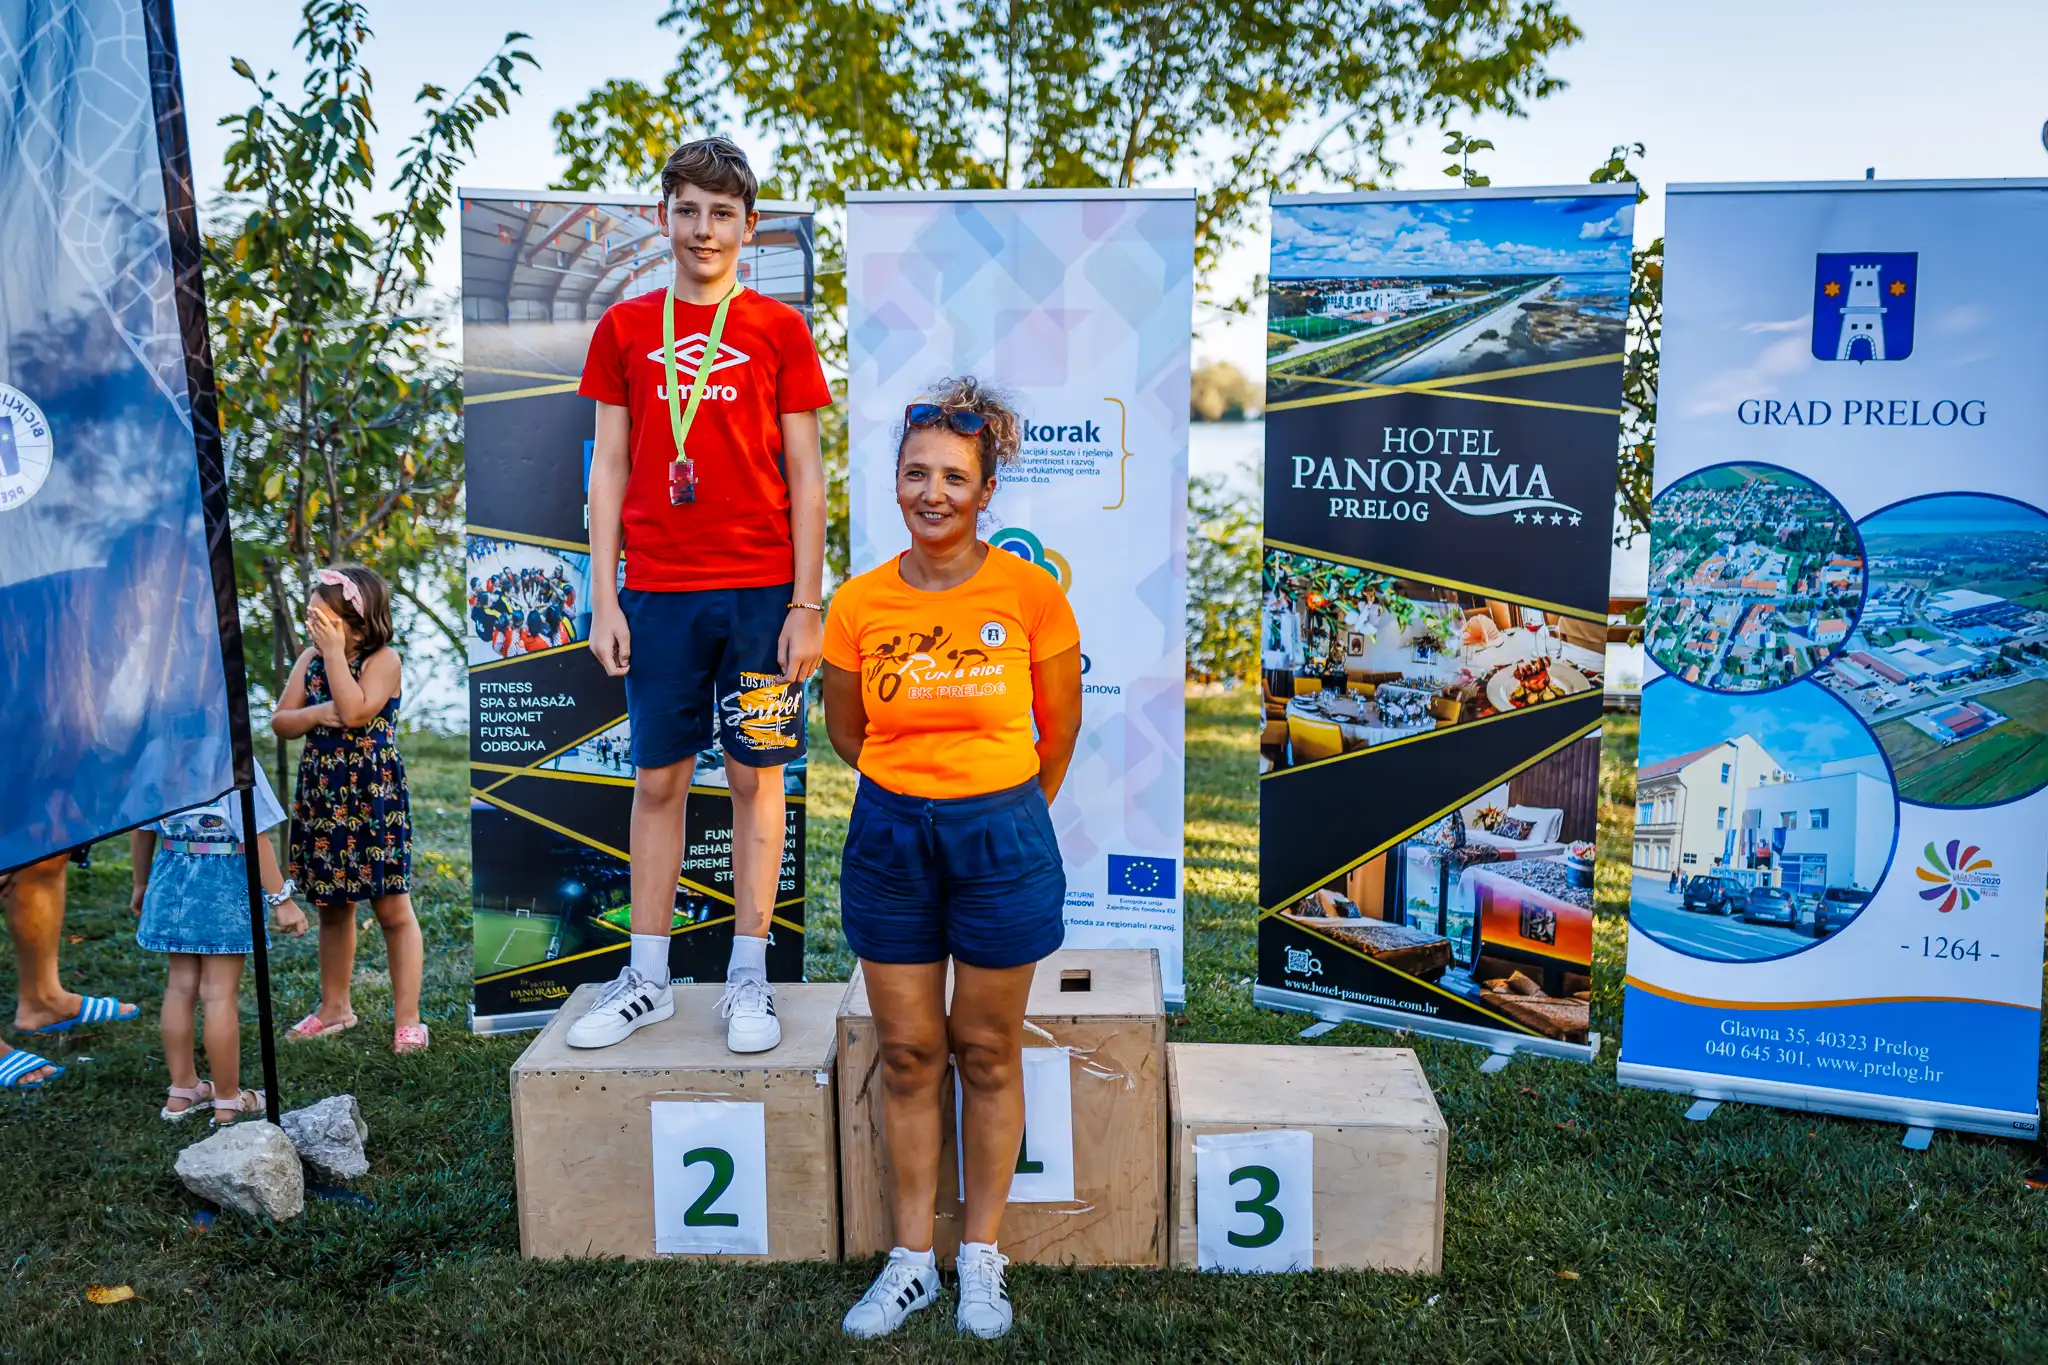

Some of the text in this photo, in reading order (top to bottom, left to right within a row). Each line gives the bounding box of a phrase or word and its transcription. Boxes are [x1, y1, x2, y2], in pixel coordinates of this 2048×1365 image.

[1737, 398, 1987, 427] GRAD PRELOG
[1382, 426, 1501, 456] HOTEL
[1050, 448, 1076, 457] sustav
[1082, 448, 1113, 458] rješenja
[1071, 458, 1095, 467] razvoj
[1026, 466, 1074, 476] edukativnog
[1075, 467, 1101, 476] centra
[1031, 475, 1051, 483] d.o.o.
[1291, 455, 1560, 503] PANORAMA
[1329, 497, 1430, 522] PRELOG
[969, 664, 1005, 677] RIDE
[479, 681, 533, 694] FITNESS
[740, 675, 758, 688] LOS
[908, 681, 1007, 700] BK PRELOG
[479, 693, 576, 708] SPA & MASAŽA
[480, 711, 544, 723] RUKOMET
[720, 687, 803, 738] Surfer
[480, 726, 531, 738] FUTSAL
[480, 740, 546, 752] ODBOJKA
[681, 857, 730, 870] RIPREME
[1981, 876, 2001, 885] 2020
[1064, 899, 1095, 907] ONDOVI
[1070, 918, 1094, 926] fonda
[1106, 920, 1148, 929] regionalni
[1149, 924, 1177, 933] razvoj.
[1922, 935, 1982, 962] 1264
[510, 986, 569, 999] PANORAMA
[1284, 978, 1440, 1015] www.hotel-panorama.com.hr
[1720, 1019, 1930, 1062] Glavna 35, 40323 Prelog
[1705, 1039, 1944, 1084] 040 645 301, www.prelog.hr
[681, 1146, 740, 1229] 2
[1226, 1165, 1286, 1250] 3
